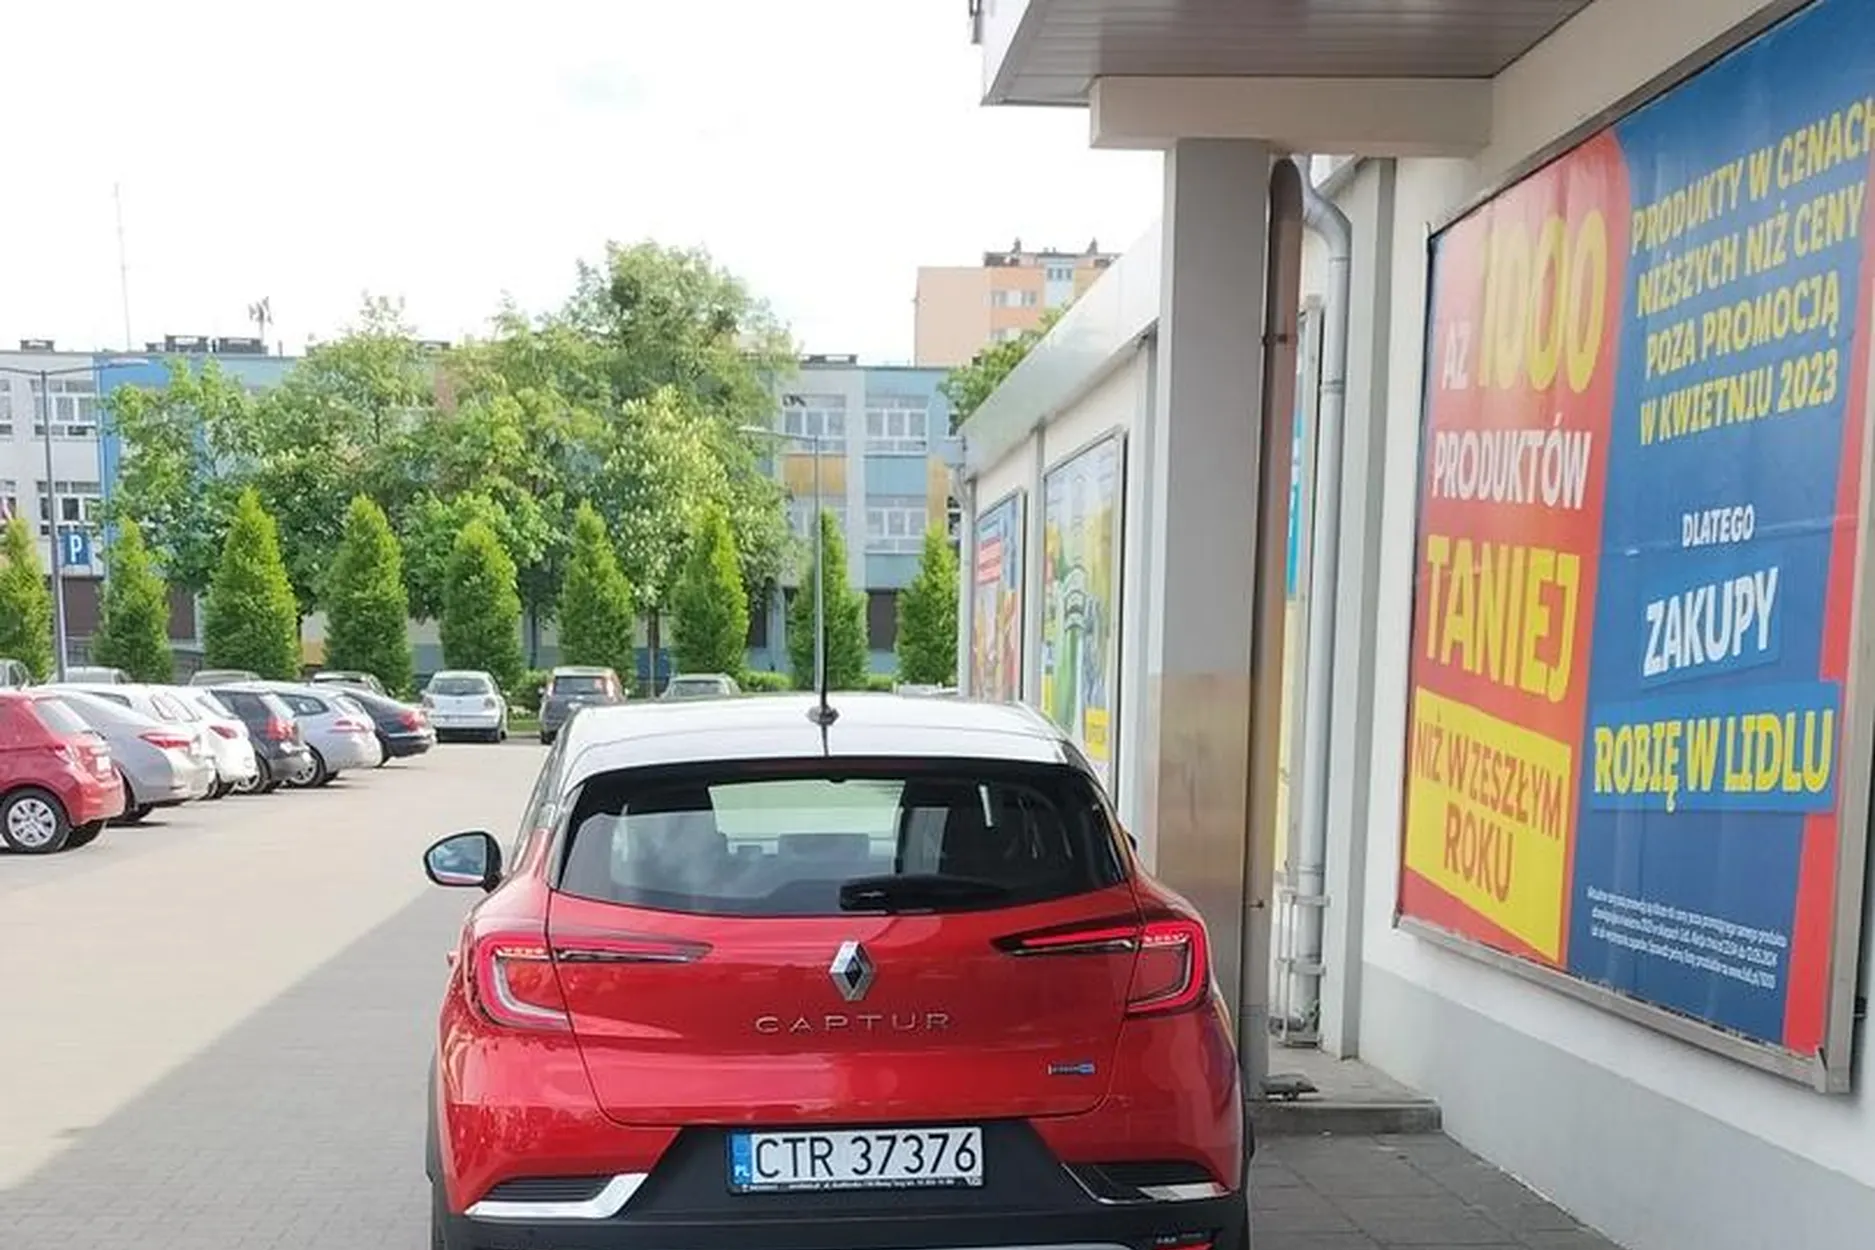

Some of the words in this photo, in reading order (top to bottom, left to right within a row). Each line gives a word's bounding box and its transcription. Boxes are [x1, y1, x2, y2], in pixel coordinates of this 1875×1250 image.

[1632, 157, 1744, 256] PRODUKTY
[1749, 144, 1774, 201] W
[1777, 96, 1875, 190] CENACH
[1636, 232, 1739, 318] NIŻSZYCH
[1745, 199, 1789, 277] NIŻ
[1794, 180, 1866, 258] CENY
[1478, 210, 1607, 394] 1000
[1646, 318, 1697, 381] POZA
[1702, 270, 1840, 361] PROMOCJĄ
[1640, 397, 1656, 446] W
[1659, 365, 1773, 442] KWIETNIU
[1777, 347, 1838, 413] 2023
[1432, 411, 1593, 510] PRODUKTÓW
[70, 534, 83, 563] P
[1681, 503, 1756, 548] DLATEGO
[1426, 533, 1581, 703] TANIEJ
[1643, 566, 1780, 677] ZAKUPY
[1415, 708, 1444, 783] NIŻ
[1448, 731, 1469, 794] W
[1469, 740, 1564, 841] ZESZŁYM
[1593, 719, 1682, 813] ROBIĘ
[1686, 716, 1721, 793] W
[1724, 708, 1835, 793] LIDLU
[1443, 800, 1514, 903] ROKU
[754, 1012, 952, 1034] CAPTUR
[754, 1136, 834, 1179] CTR
[850, 1131, 977, 1176] 37376
